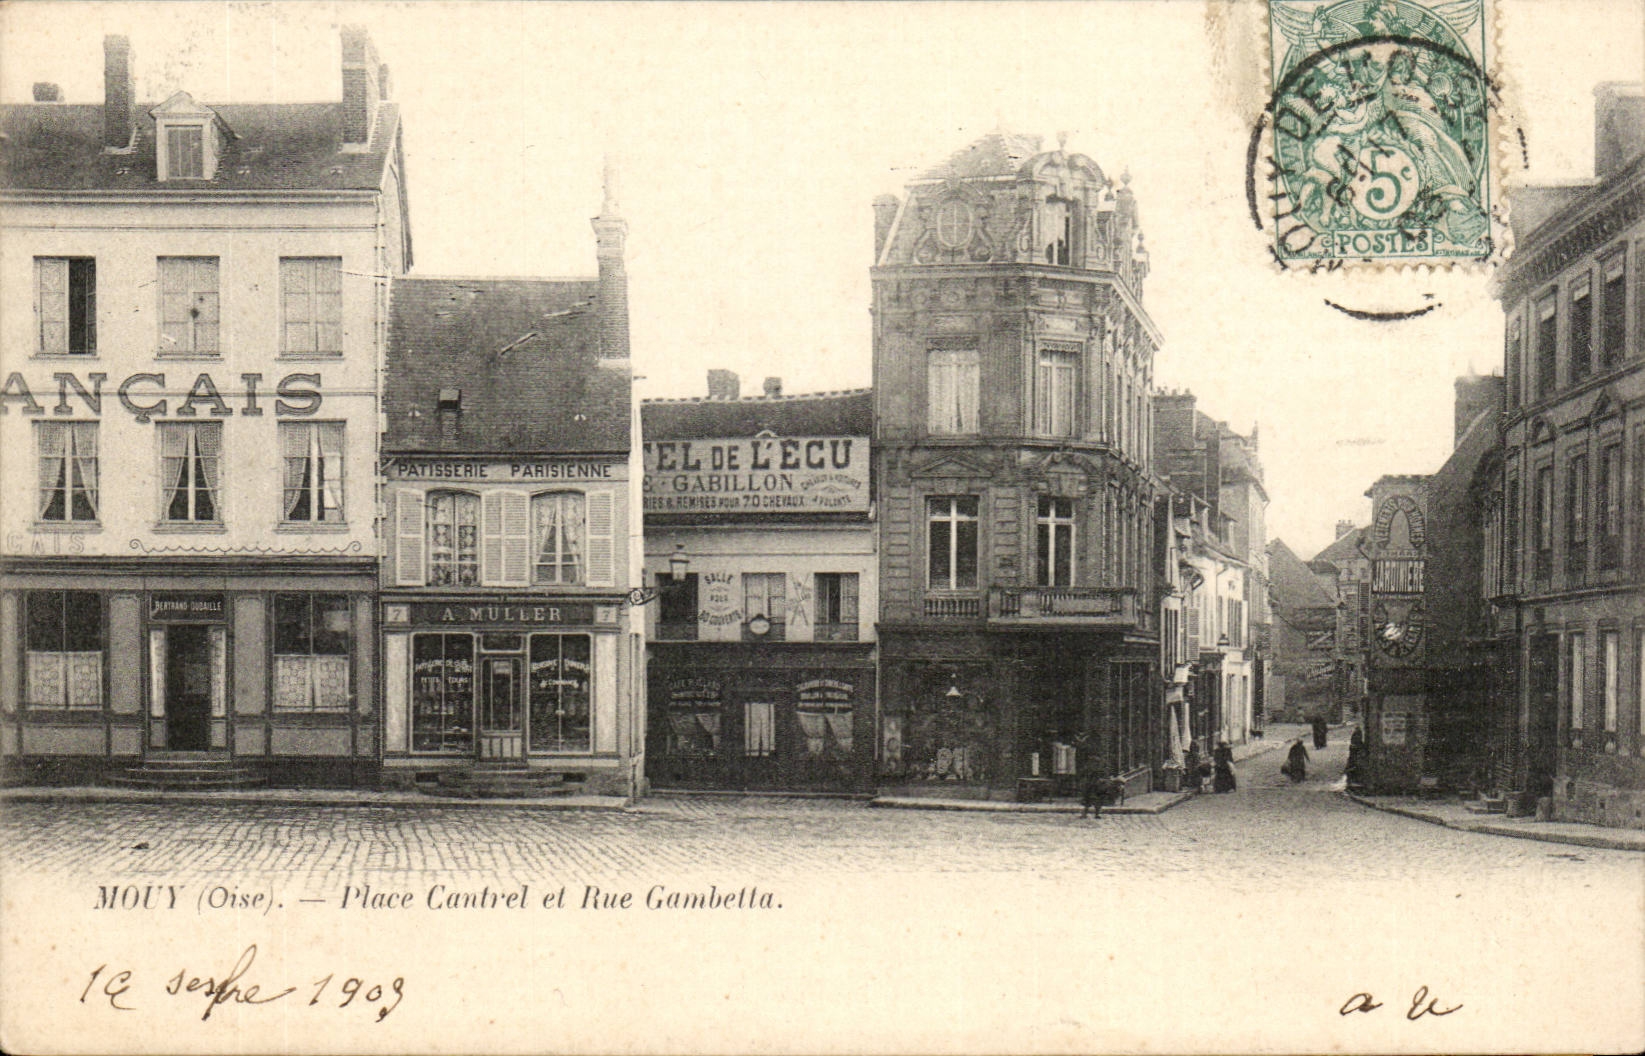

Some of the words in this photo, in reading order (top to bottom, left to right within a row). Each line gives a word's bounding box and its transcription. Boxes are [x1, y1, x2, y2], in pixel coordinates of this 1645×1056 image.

[1335, 232, 1429, 255] POSTES
[711, 446, 740, 471] DE
[398, 463, 489, 478] PATISSERIE
[511, 463, 612, 478] PARISIENNE
[672, 473, 793, 492] GABILLON
[743, 494, 760, 508] 70
[763, 495, 805, 508] CHEVAUX
